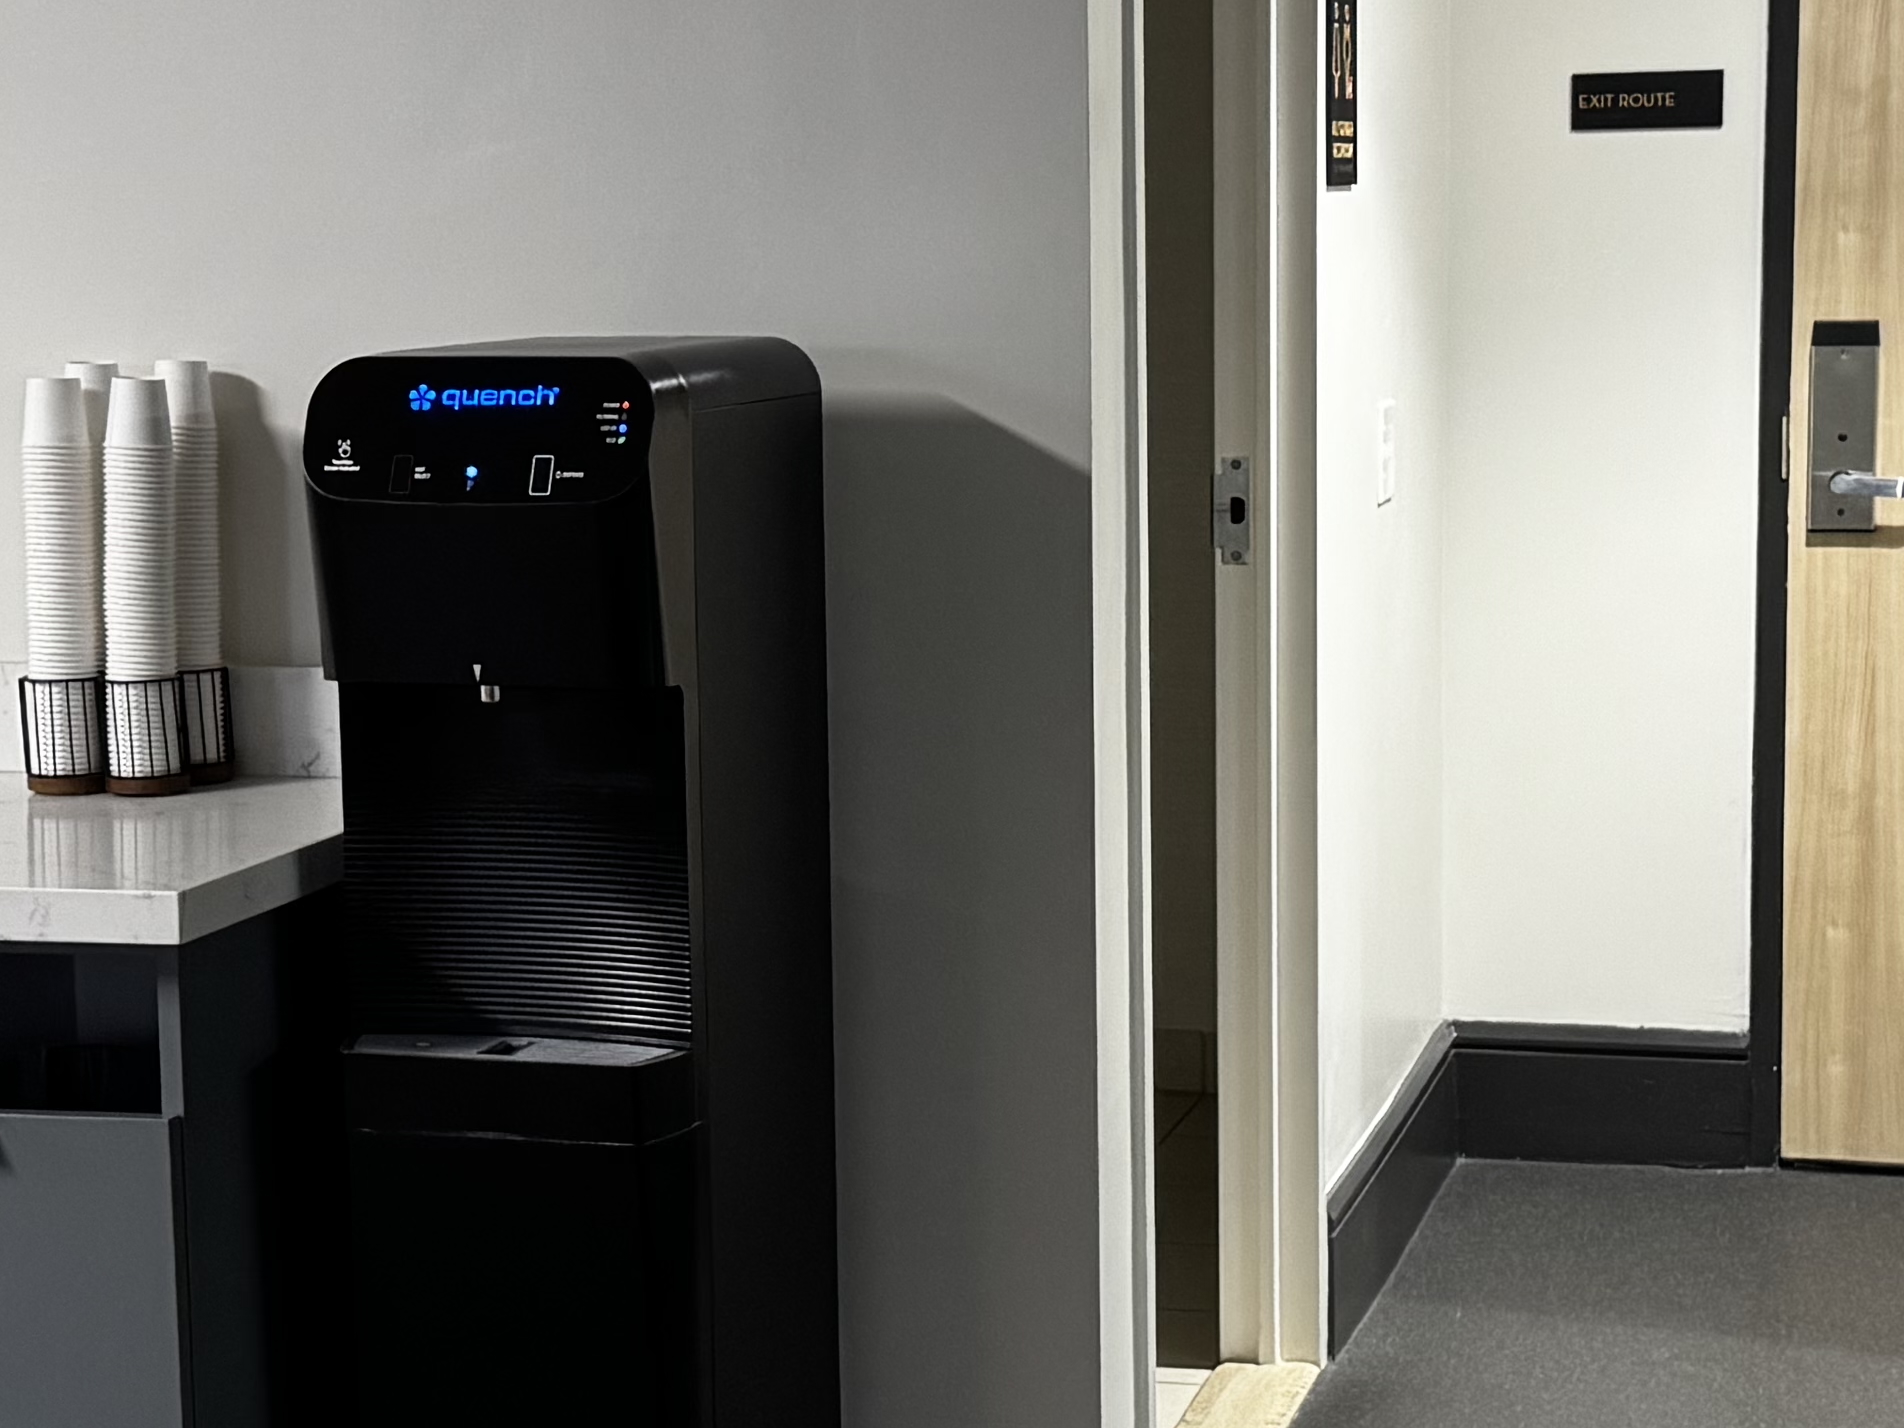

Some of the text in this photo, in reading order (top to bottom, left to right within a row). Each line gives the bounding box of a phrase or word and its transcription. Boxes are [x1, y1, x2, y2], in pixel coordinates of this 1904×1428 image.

[1578, 91, 1675, 109] EXIT ROUTE
[441, 384, 556, 410] quench
